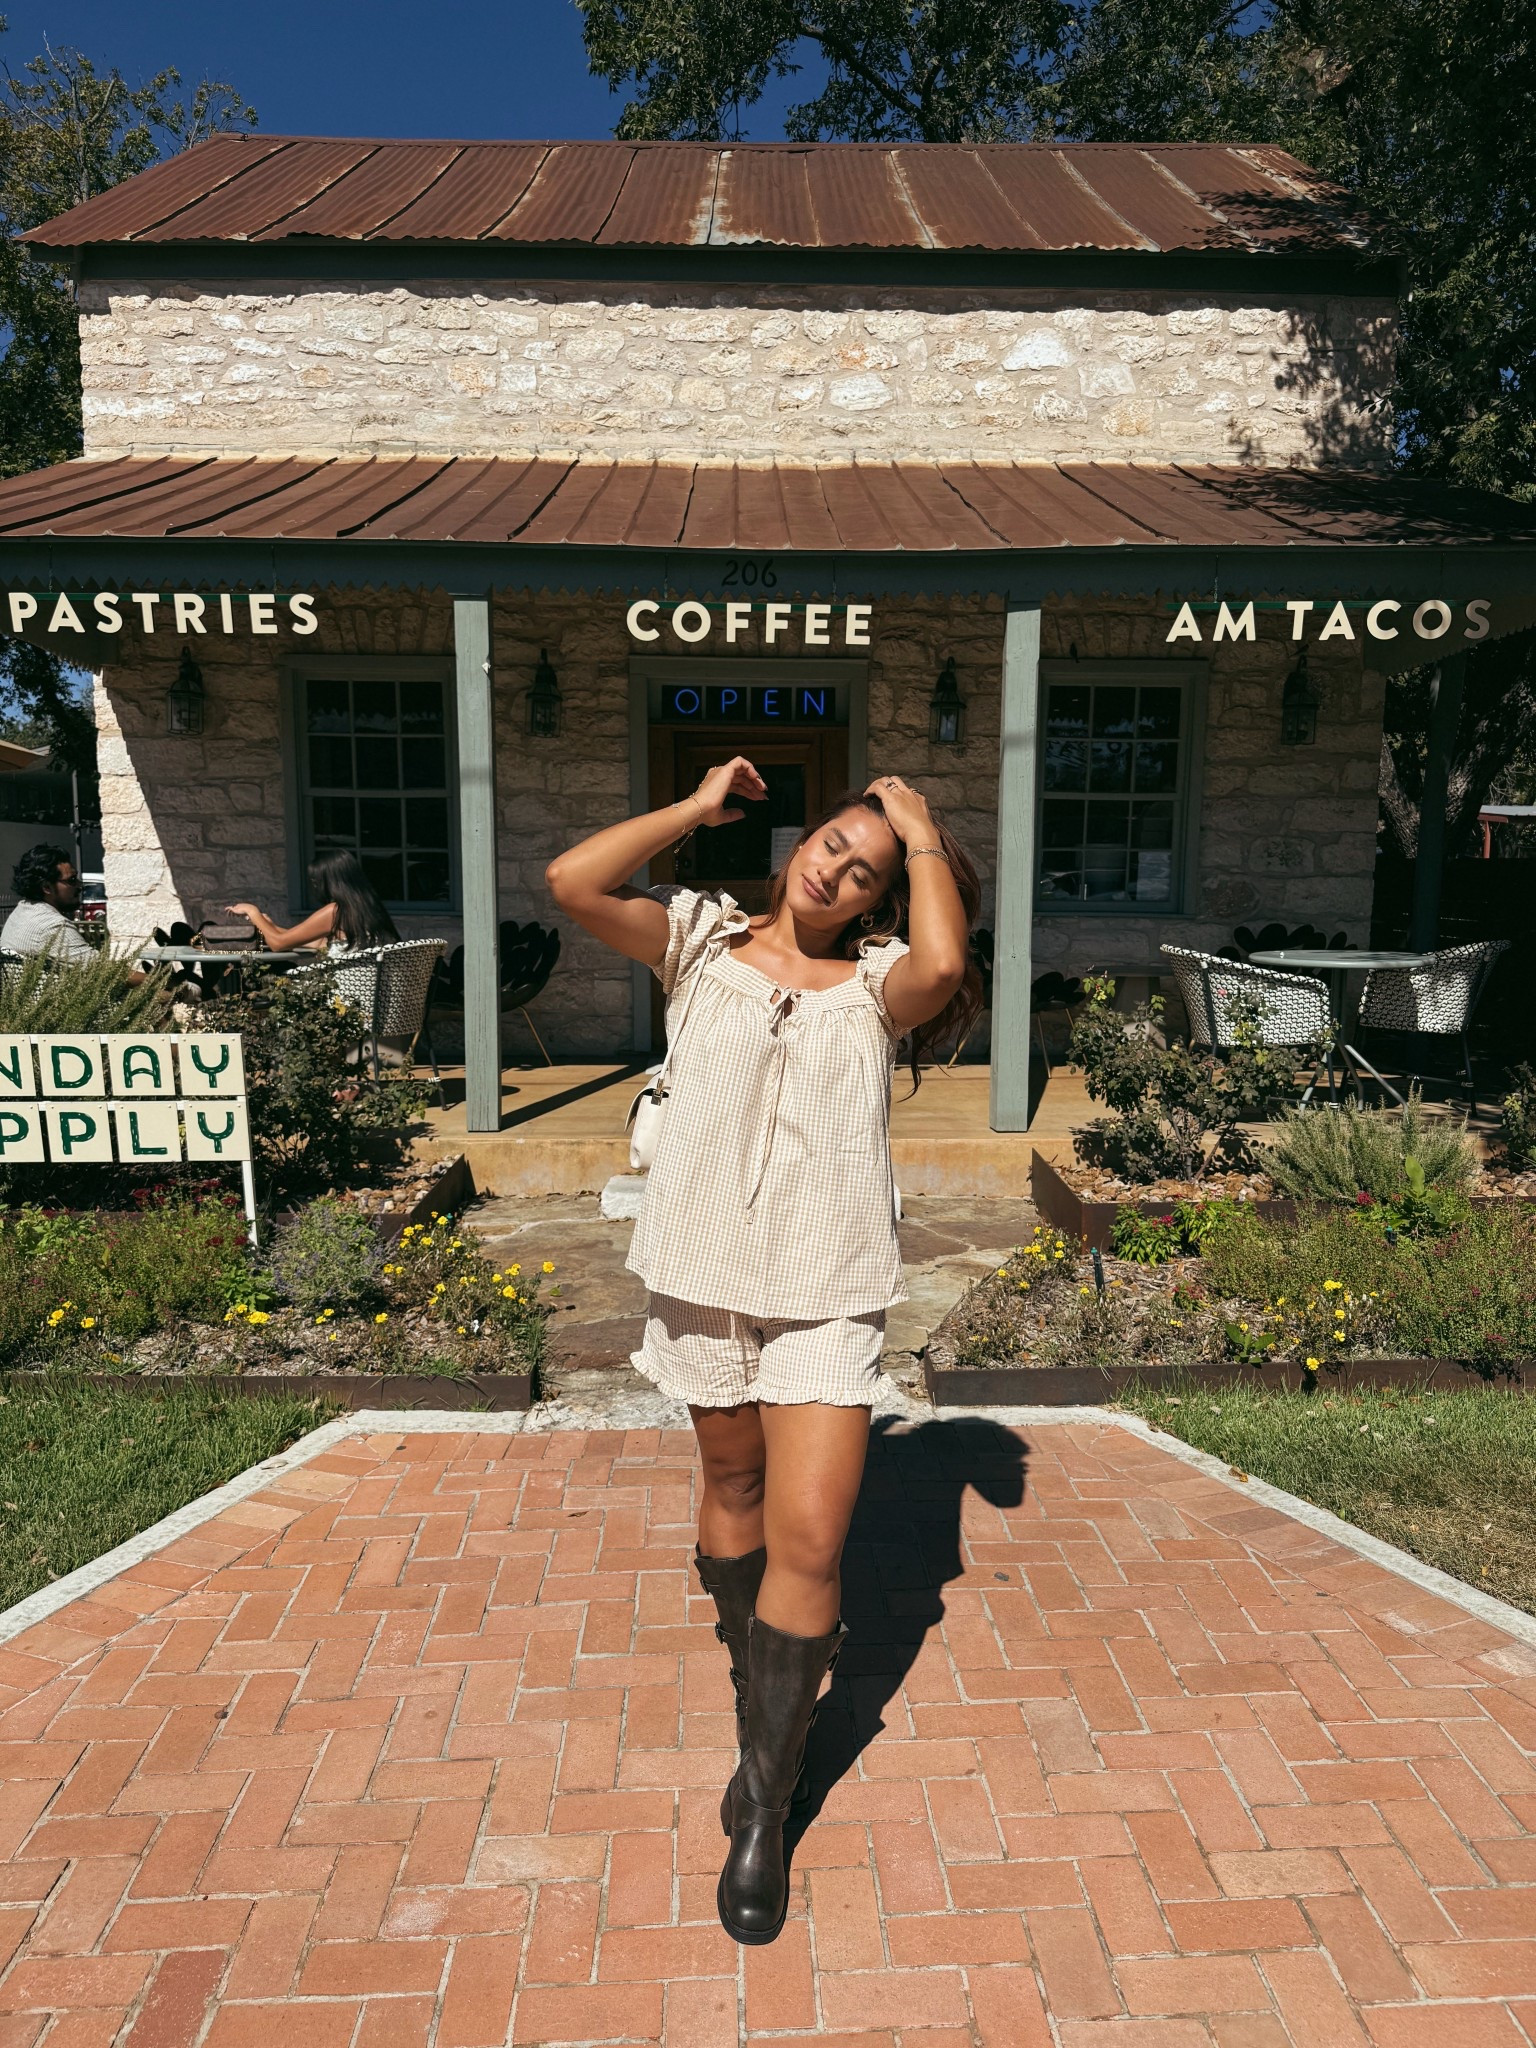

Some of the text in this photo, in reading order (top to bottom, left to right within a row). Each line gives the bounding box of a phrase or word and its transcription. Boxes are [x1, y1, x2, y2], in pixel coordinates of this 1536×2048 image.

[720, 559, 778, 588] 206
[8, 592, 319, 635] PASTRIES
[626, 599, 872, 645] COFFEE
[1165, 599, 1492, 642] AM TACOS
[674, 688, 826, 716] OPEN
[0, 1111, 235, 1156] PPLY
